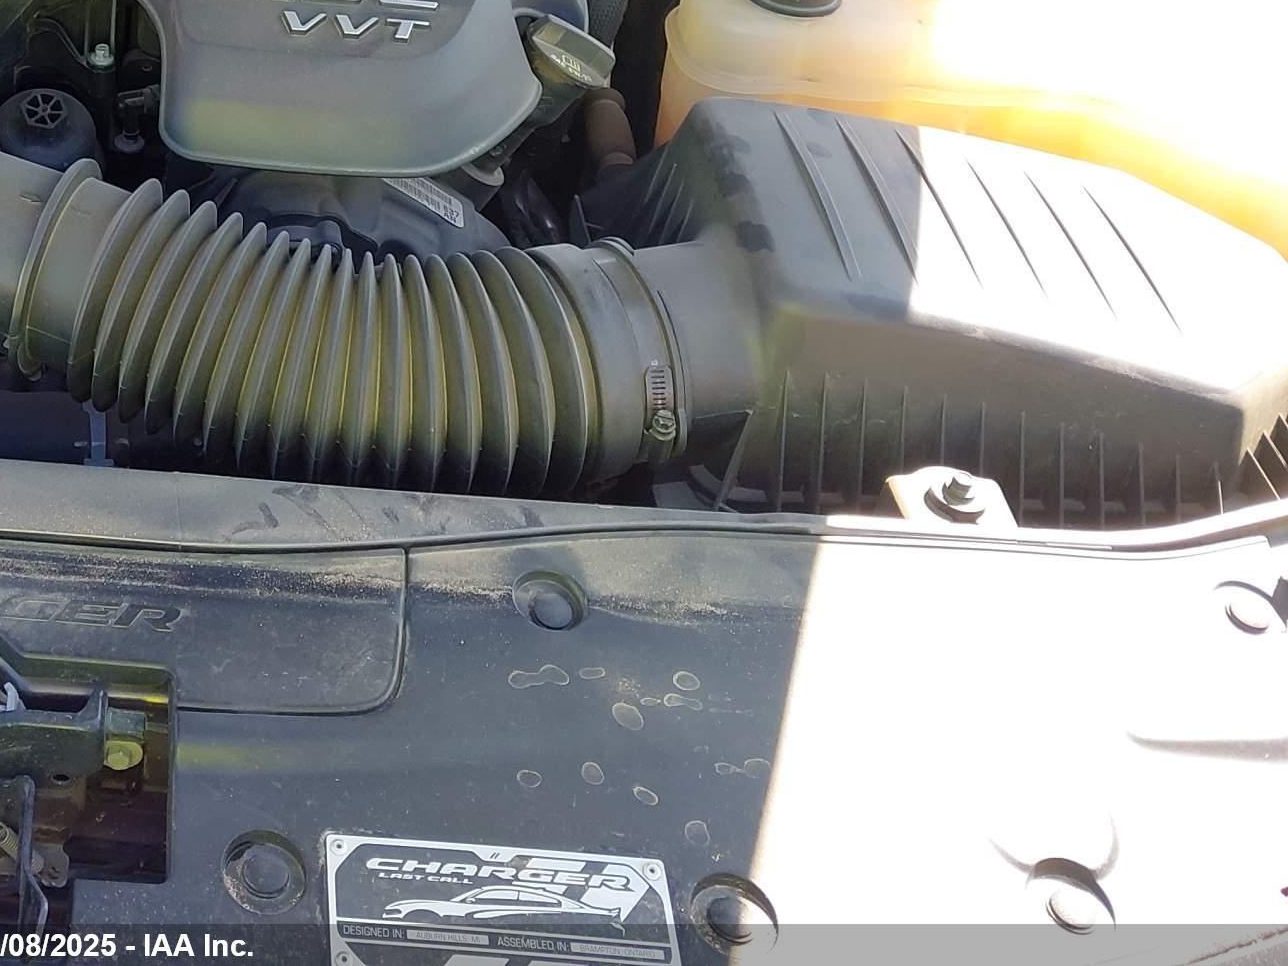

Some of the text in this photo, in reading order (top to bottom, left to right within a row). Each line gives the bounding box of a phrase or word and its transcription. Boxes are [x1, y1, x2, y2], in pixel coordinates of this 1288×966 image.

[281, 10, 432, 42] VVT
[366, 857, 635, 892] CHARGER
[379, 872, 474, 884] LAST CALL
[343, 924, 390, 938] DESIGNED
[497, 936, 554, 951] ASSEMBLED
[556, 942, 570, 952] IN:
